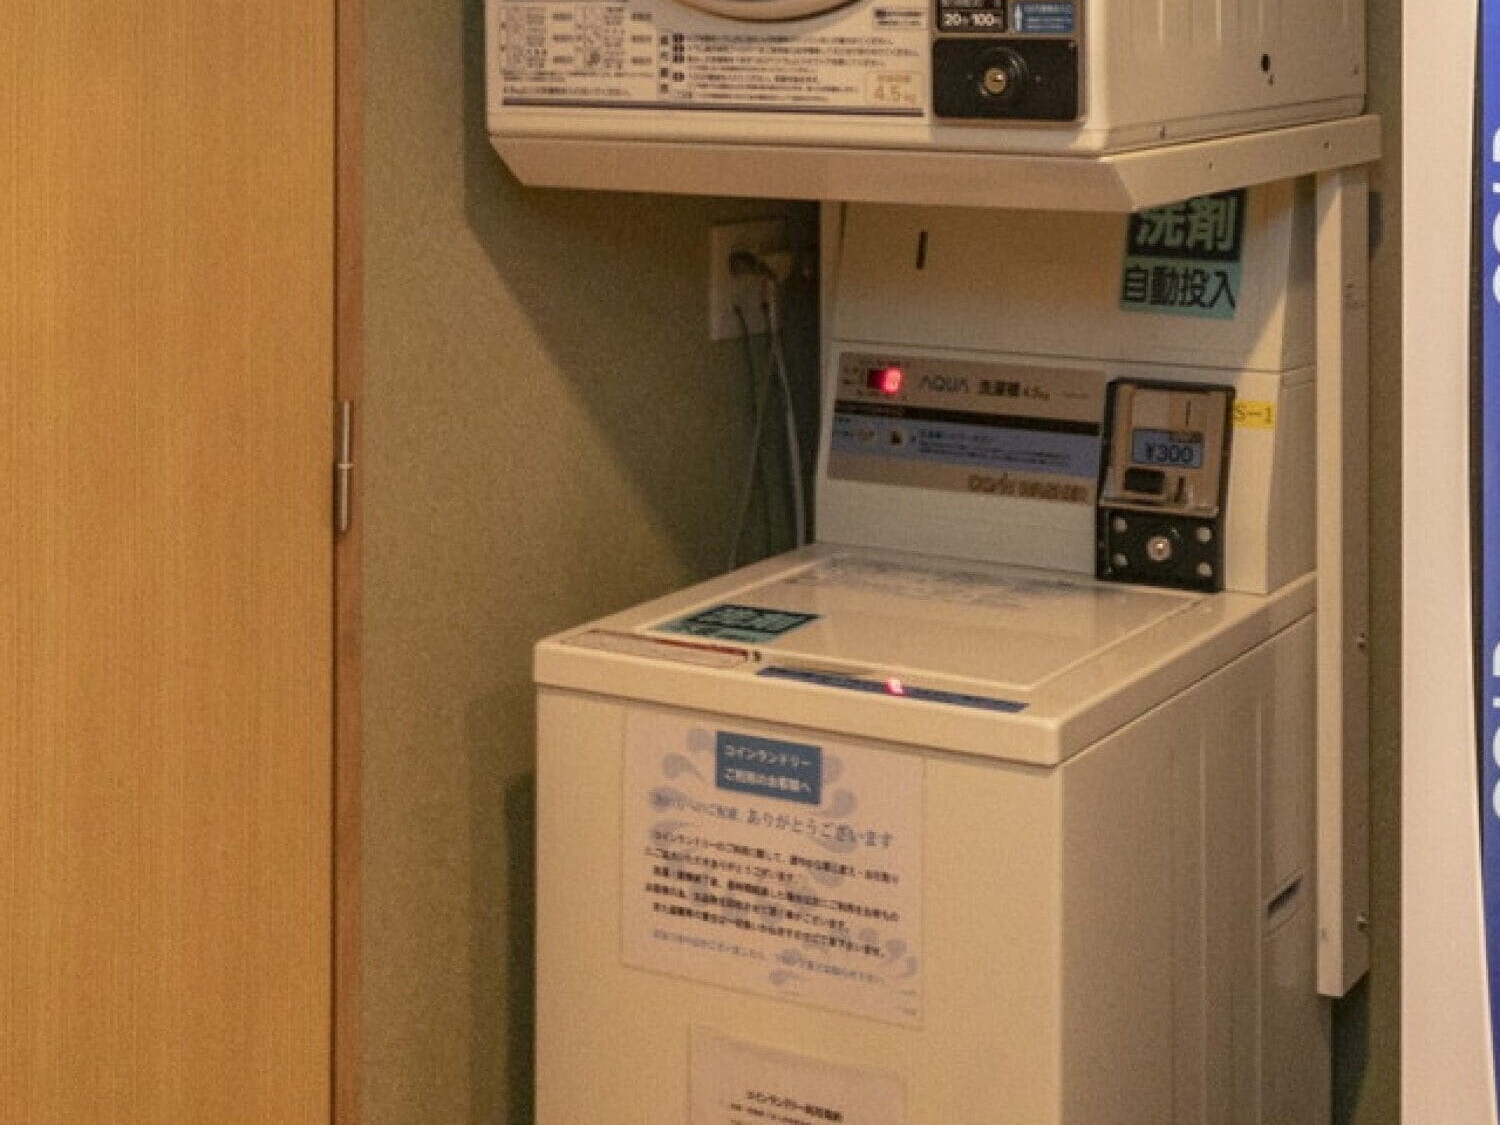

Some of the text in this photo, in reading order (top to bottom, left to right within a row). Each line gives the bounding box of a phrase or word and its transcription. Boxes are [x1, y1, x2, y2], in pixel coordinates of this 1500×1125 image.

[1135, 197, 1237, 252] 洗剤
[1123, 263, 1236, 310] 自動投入
[919, 375, 969, 394] AQUA
